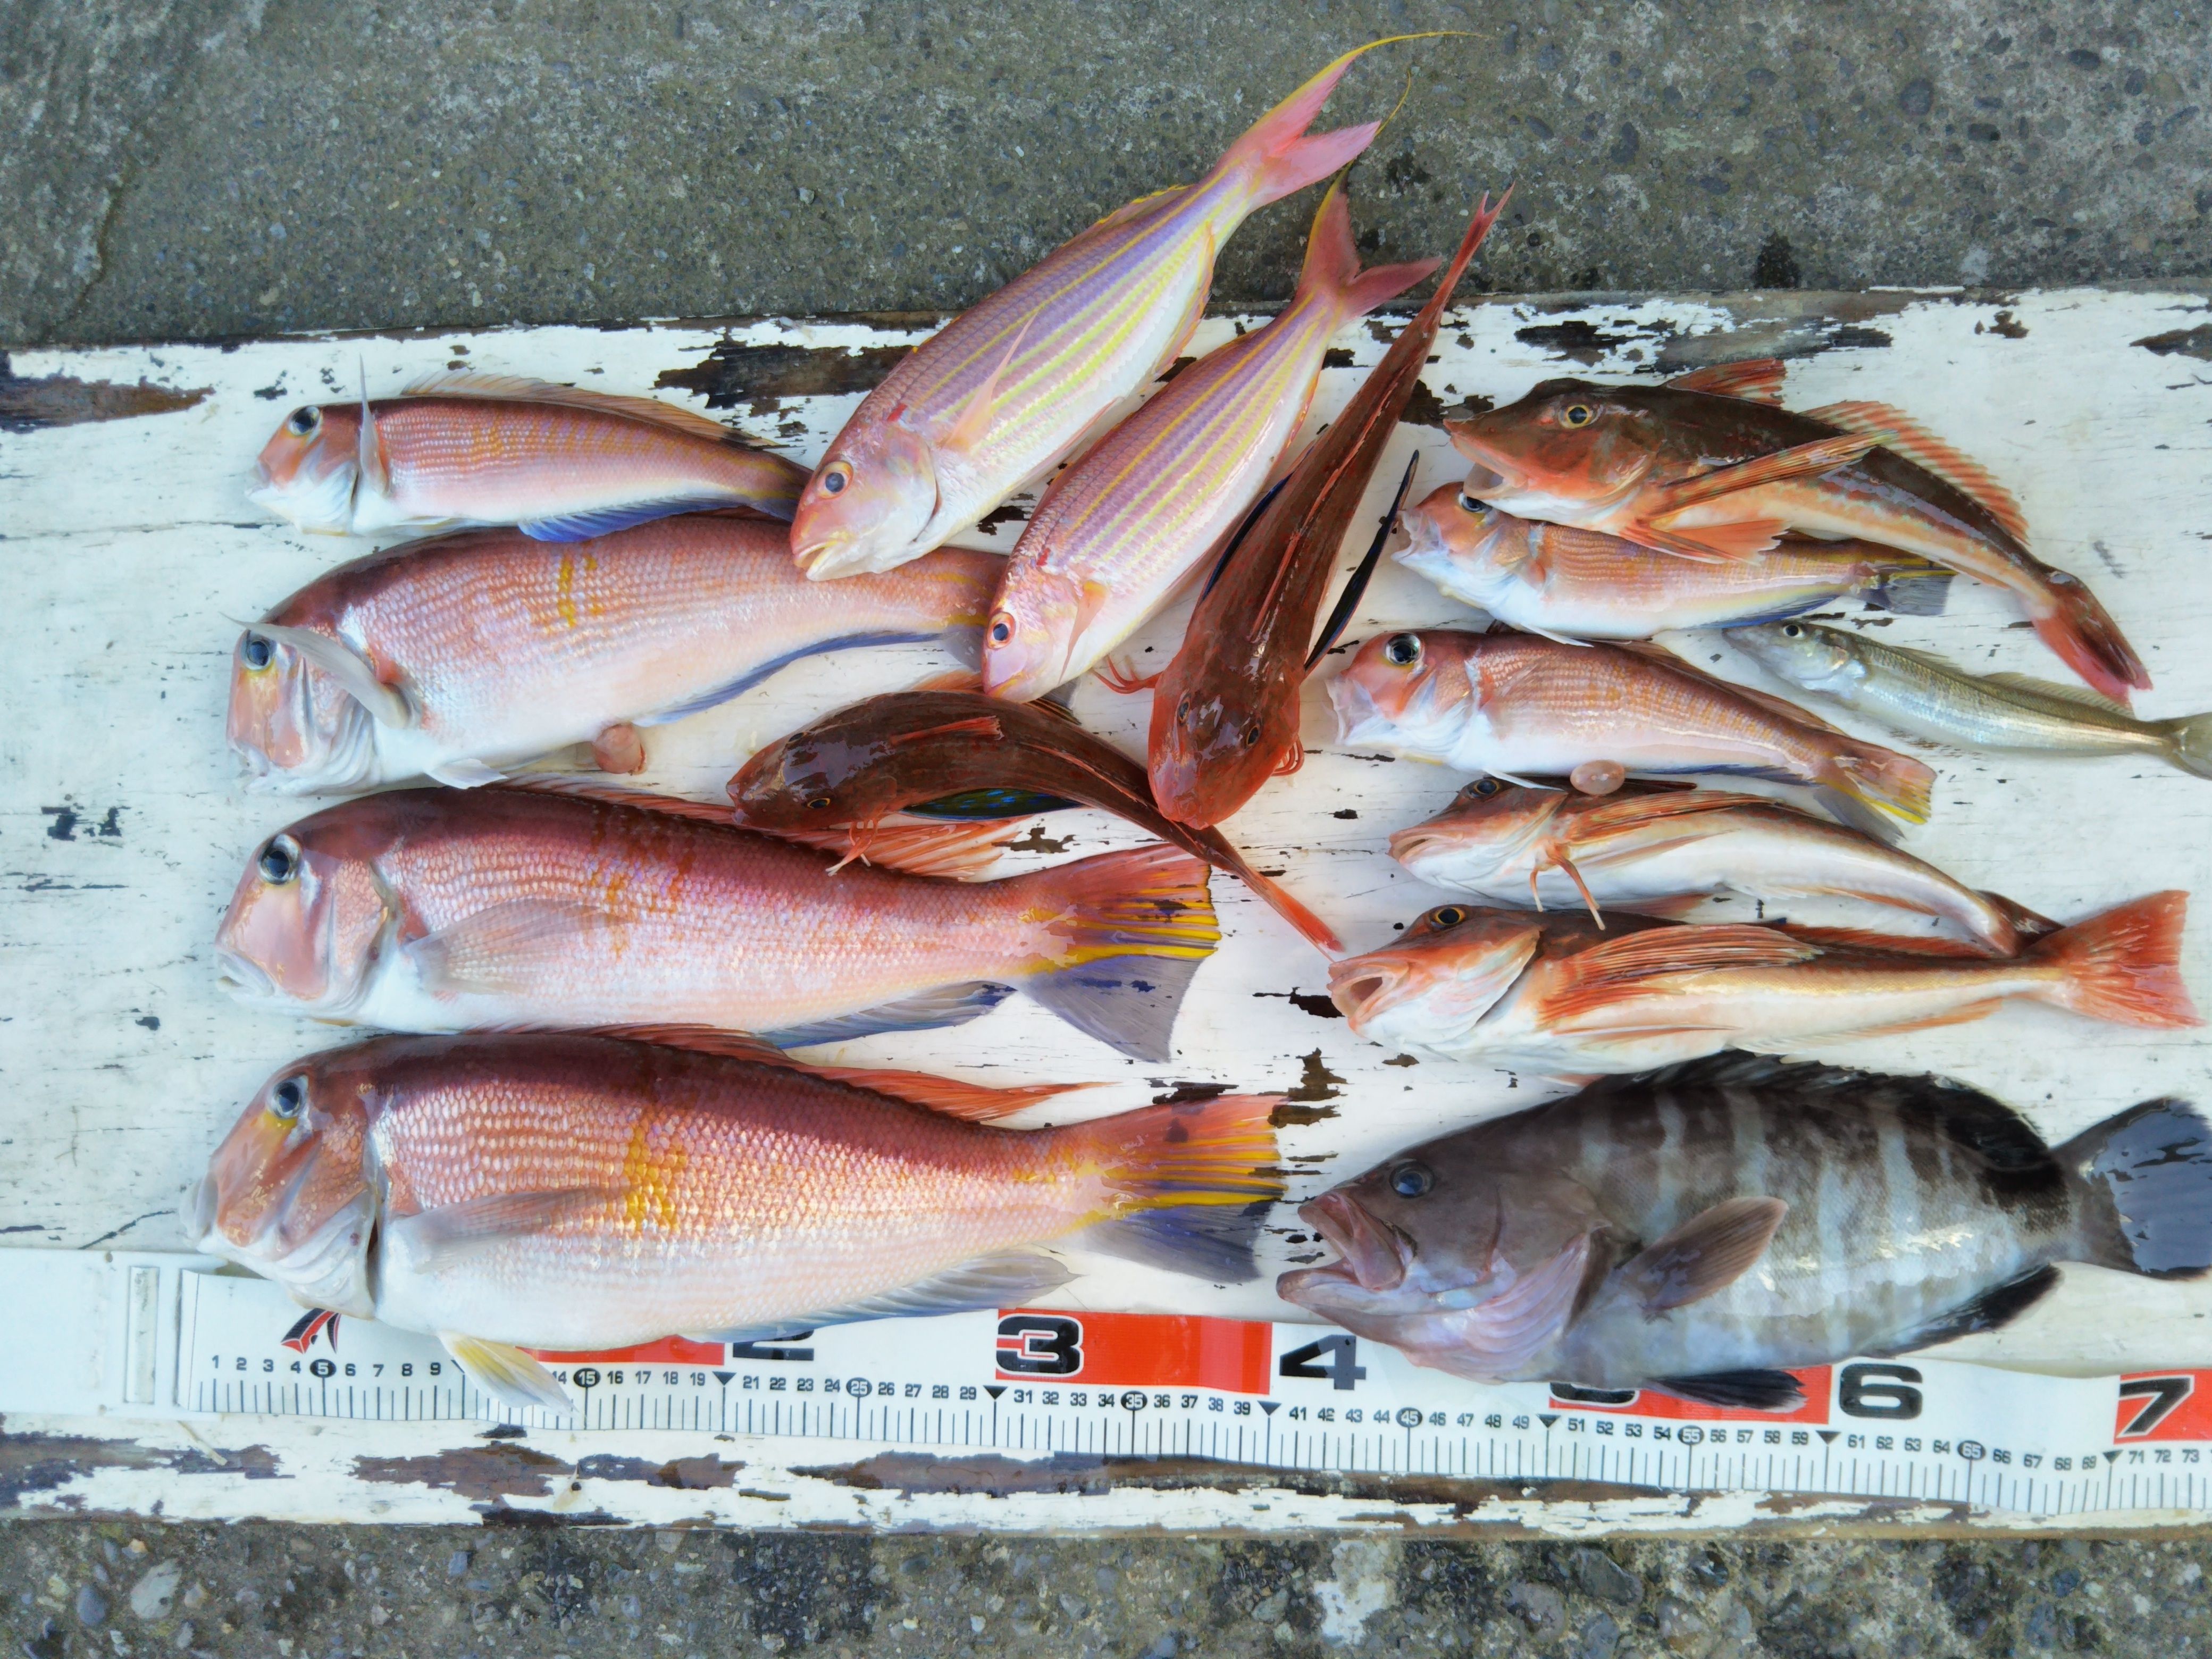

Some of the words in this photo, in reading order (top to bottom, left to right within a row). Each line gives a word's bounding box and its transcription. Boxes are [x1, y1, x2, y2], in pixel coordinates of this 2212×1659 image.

[212, 1355, 219, 1369] 1
[236, 1357, 247, 1371] 2
[263, 1359, 274, 1372] 3
[290, 1361, 301, 1373] 4
[316, 1362, 329, 1376] 5
[345, 1363, 356, 1377] 6
[373, 1364, 384, 1377] 7
[401, 1363, 413, 1377] 8
[430, 1362, 441, 1376] 9
[578, 1370, 596, 1385] 15
[607, 1370, 623, 1385] 16
[635, 1370, 651, 1384] 17
[663, 1371, 678, 1385] 18
[690, 1372, 706, 1386] 19
[743, 1375, 759, 1389] 21
[769, 1377, 786, 1391] 22
[797, 1378, 814, 1392] 23
[824, 1378, 841, 1393] 24
[850, 1380, 868, 1395] 25
[878, 1381, 895, 1396] 26
[904, 1383, 922, 1398] 27
[932, 1385, 949, 1399] 28
[959, 1386, 977, 1401] 29
[1013, 1389, 1033, 1404] 31
[1042, 1391, 1059, 1405] 32
[1070, 1392, 1087, 1407] 33
[1098, 1394, 1115, 1407] 34
[1125, 1393, 1144, 1409] 35
[1154, 1394, 1170, 1408] 36
[1181, 1394, 1198, 1409] 37
[1208, 1397, 1224, 1412] 38
[1234, 1401, 1251, 1415] 39
[1289, 1406, 1306, 1421] 41
[1317, 1407, 1335, 1422] 42
[1345, 1409, 1363, 1423] 43
[1373, 1410, 1390, 1424] 44
[1400, 1412, 1419, 1425] 45
[1429, 1412, 1446, 1426] 46
[1457, 1413, 1474, 1427] 47
[1485, 1414, 1502, 1428] 48
[1512, 1415, 1530, 1430] 49
[1568, 1418, 1585, 1432] 51
[1596, 1421, 1614, 1436] 52
[1625, 1423, 1643, 1438] 53
[1654, 1426, 1671, 1440] 54
[1681, 1427, 1700, 1443] 55
[1710, 1429, 1727, 1443] 56
[1737, 1429, 1754, 1444] 57
[1764, 1430, 1781, 1444] 58
[1791, 1431, 1808, 1445] 59
[1847, 1434, 1865, 1448] 61
[1876, 1436, 1893, 1450] 62
[1904, 1437, 1922, 1452] 63
[1933, 1439, 1950, 1454] 64
[1963, 1443, 1981, 1459] 65
[1992, 1448, 2011, 1464] 66
[2023, 1453, 2042, 1468] 67
[2054, 1457, 2072, 1471] 68
[2082, 1455, 2097, 1470] 69
[2129, 1450, 2144, 1464] 71
[2155, 1449, 2171, 1463] 72
[2182, 1448, 2200, 1463] 73
[996, 1316, 1080, 1374] 3
[1280, 1335, 1366, 1390] 4
[1839, 1363, 1923, 1420] 6
[2119, 1377, 2191, 1436] 7
